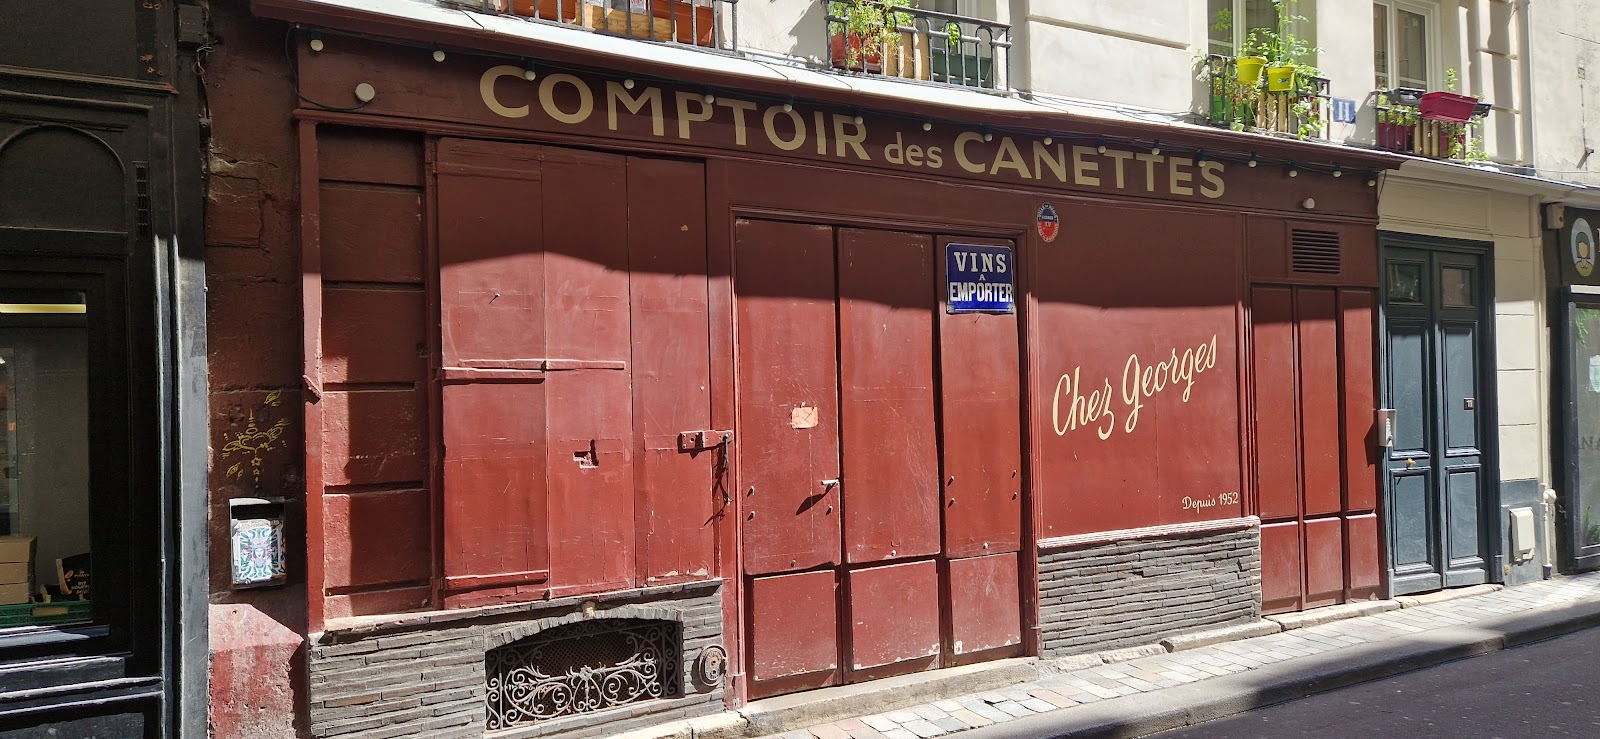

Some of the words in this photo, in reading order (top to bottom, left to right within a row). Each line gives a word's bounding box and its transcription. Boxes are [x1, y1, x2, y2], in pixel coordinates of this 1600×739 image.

[479, 65, 871, 160] COMPTOIR
[884, 132, 943, 169] des
[953, 131, 1225, 198] CANETTES
[953, 251, 1007, 273] VINS
[949, 281, 1013, 302] EMPORTER
[1052, 366, 1115, 440] Chez
[1122, 334, 1217, 433] Georges
[1182, 494, 1216, 514] Depuis
[1218, 491, 1239, 506] 1952
